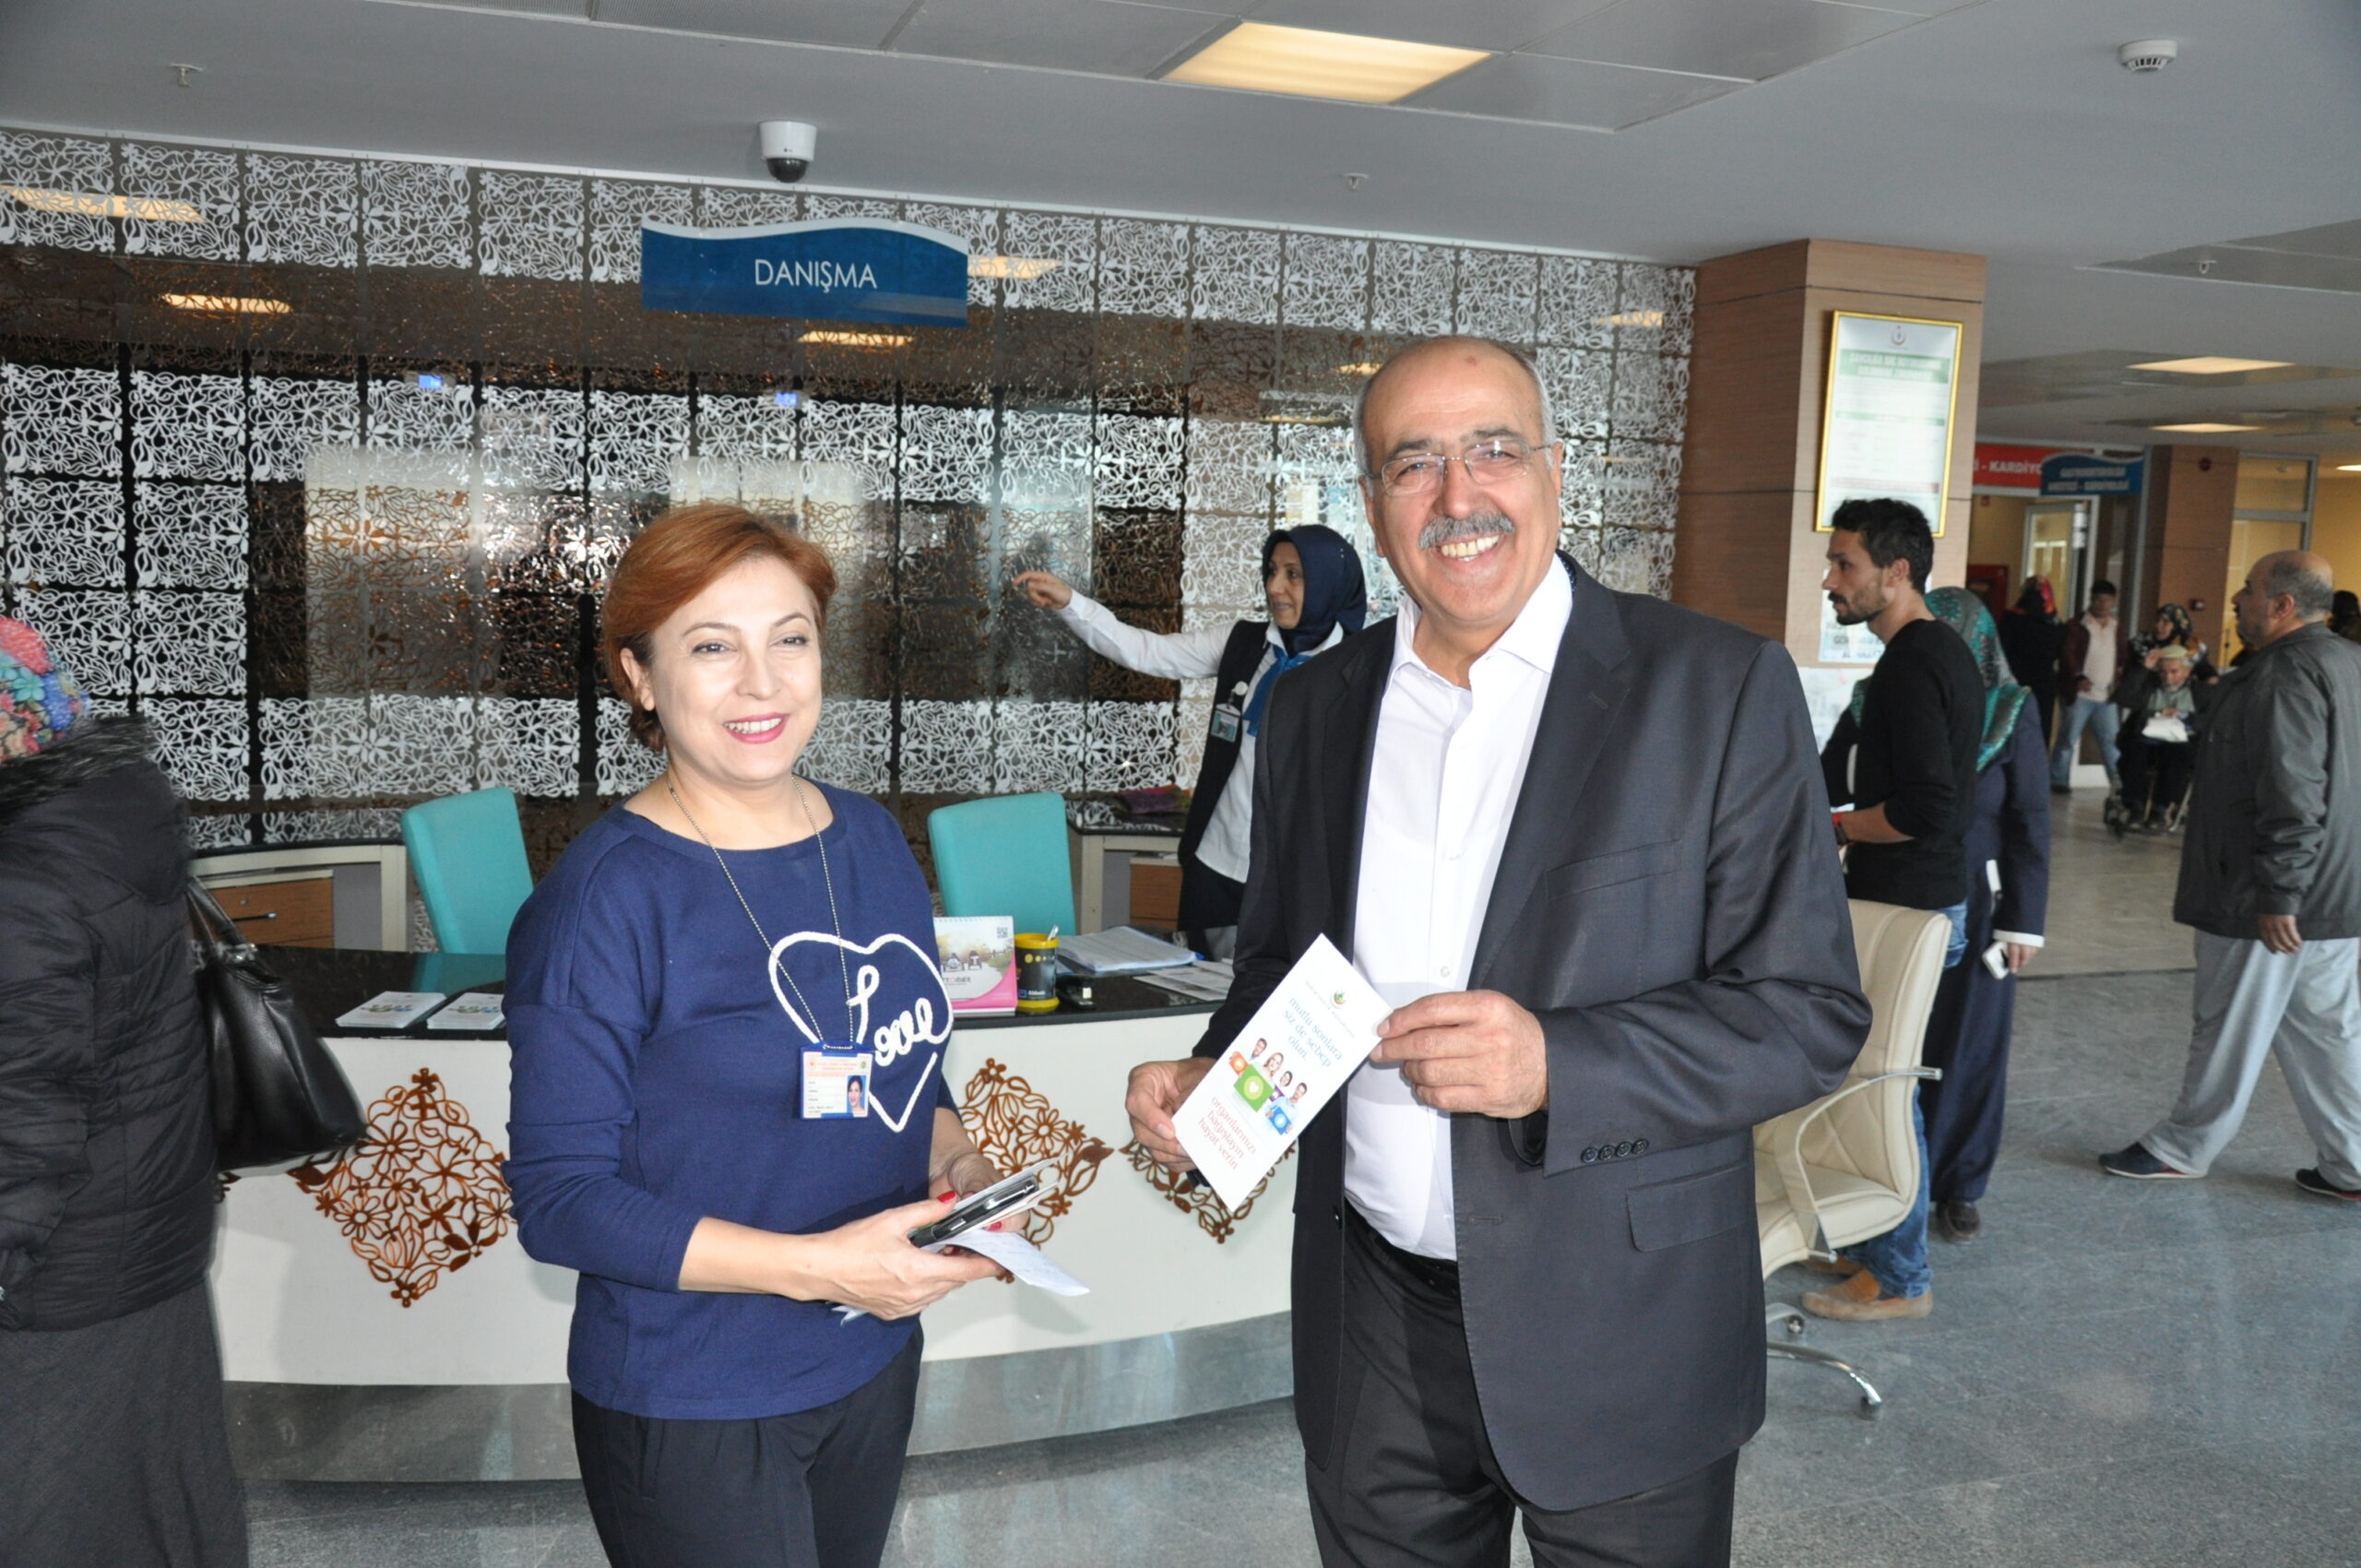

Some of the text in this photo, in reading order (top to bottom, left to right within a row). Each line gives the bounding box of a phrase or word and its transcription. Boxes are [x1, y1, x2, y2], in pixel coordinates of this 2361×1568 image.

[754, 258, 877, 293] DANIŞMA
[1283, 1010, 1297, 1025] siz
[1295, 1024, 1308, 1038] de
[1288, 997, 1313, 1027] mutlu
